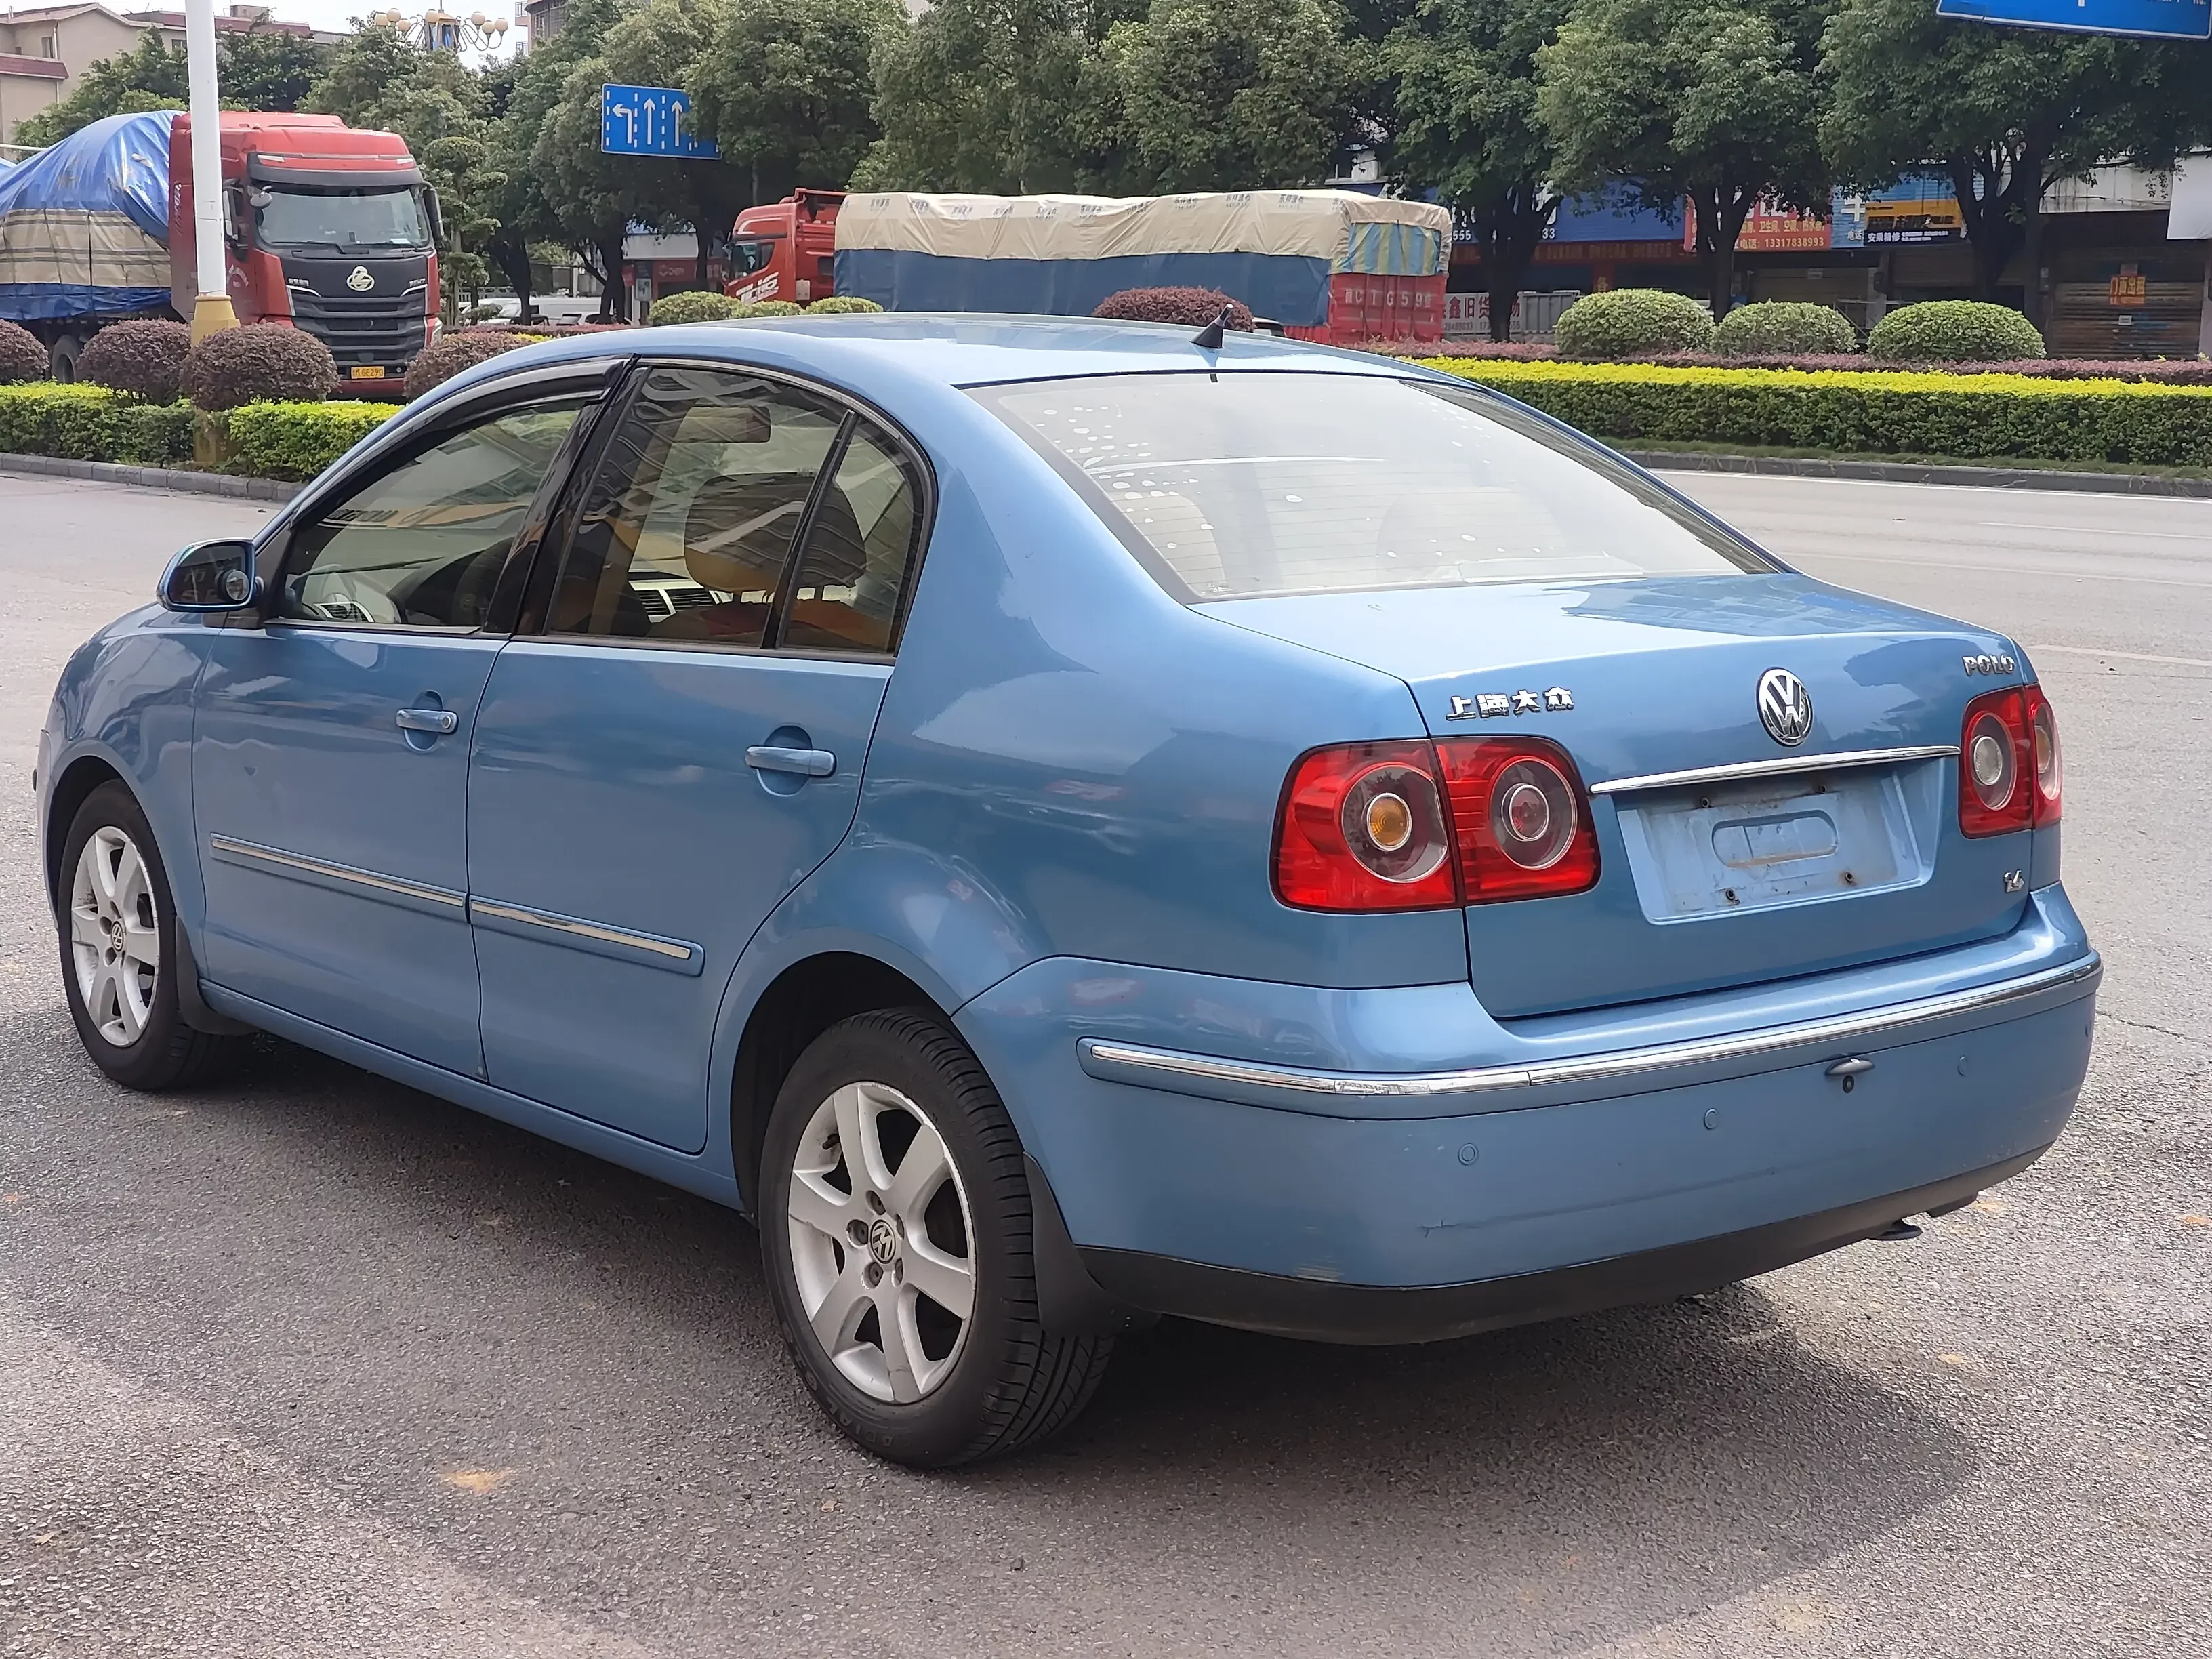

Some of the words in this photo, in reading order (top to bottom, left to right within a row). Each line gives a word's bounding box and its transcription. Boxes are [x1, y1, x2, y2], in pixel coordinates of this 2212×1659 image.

[1961, 654, 2015, 676] POLO
[1446, 686, 1574, 721] 上海大众
